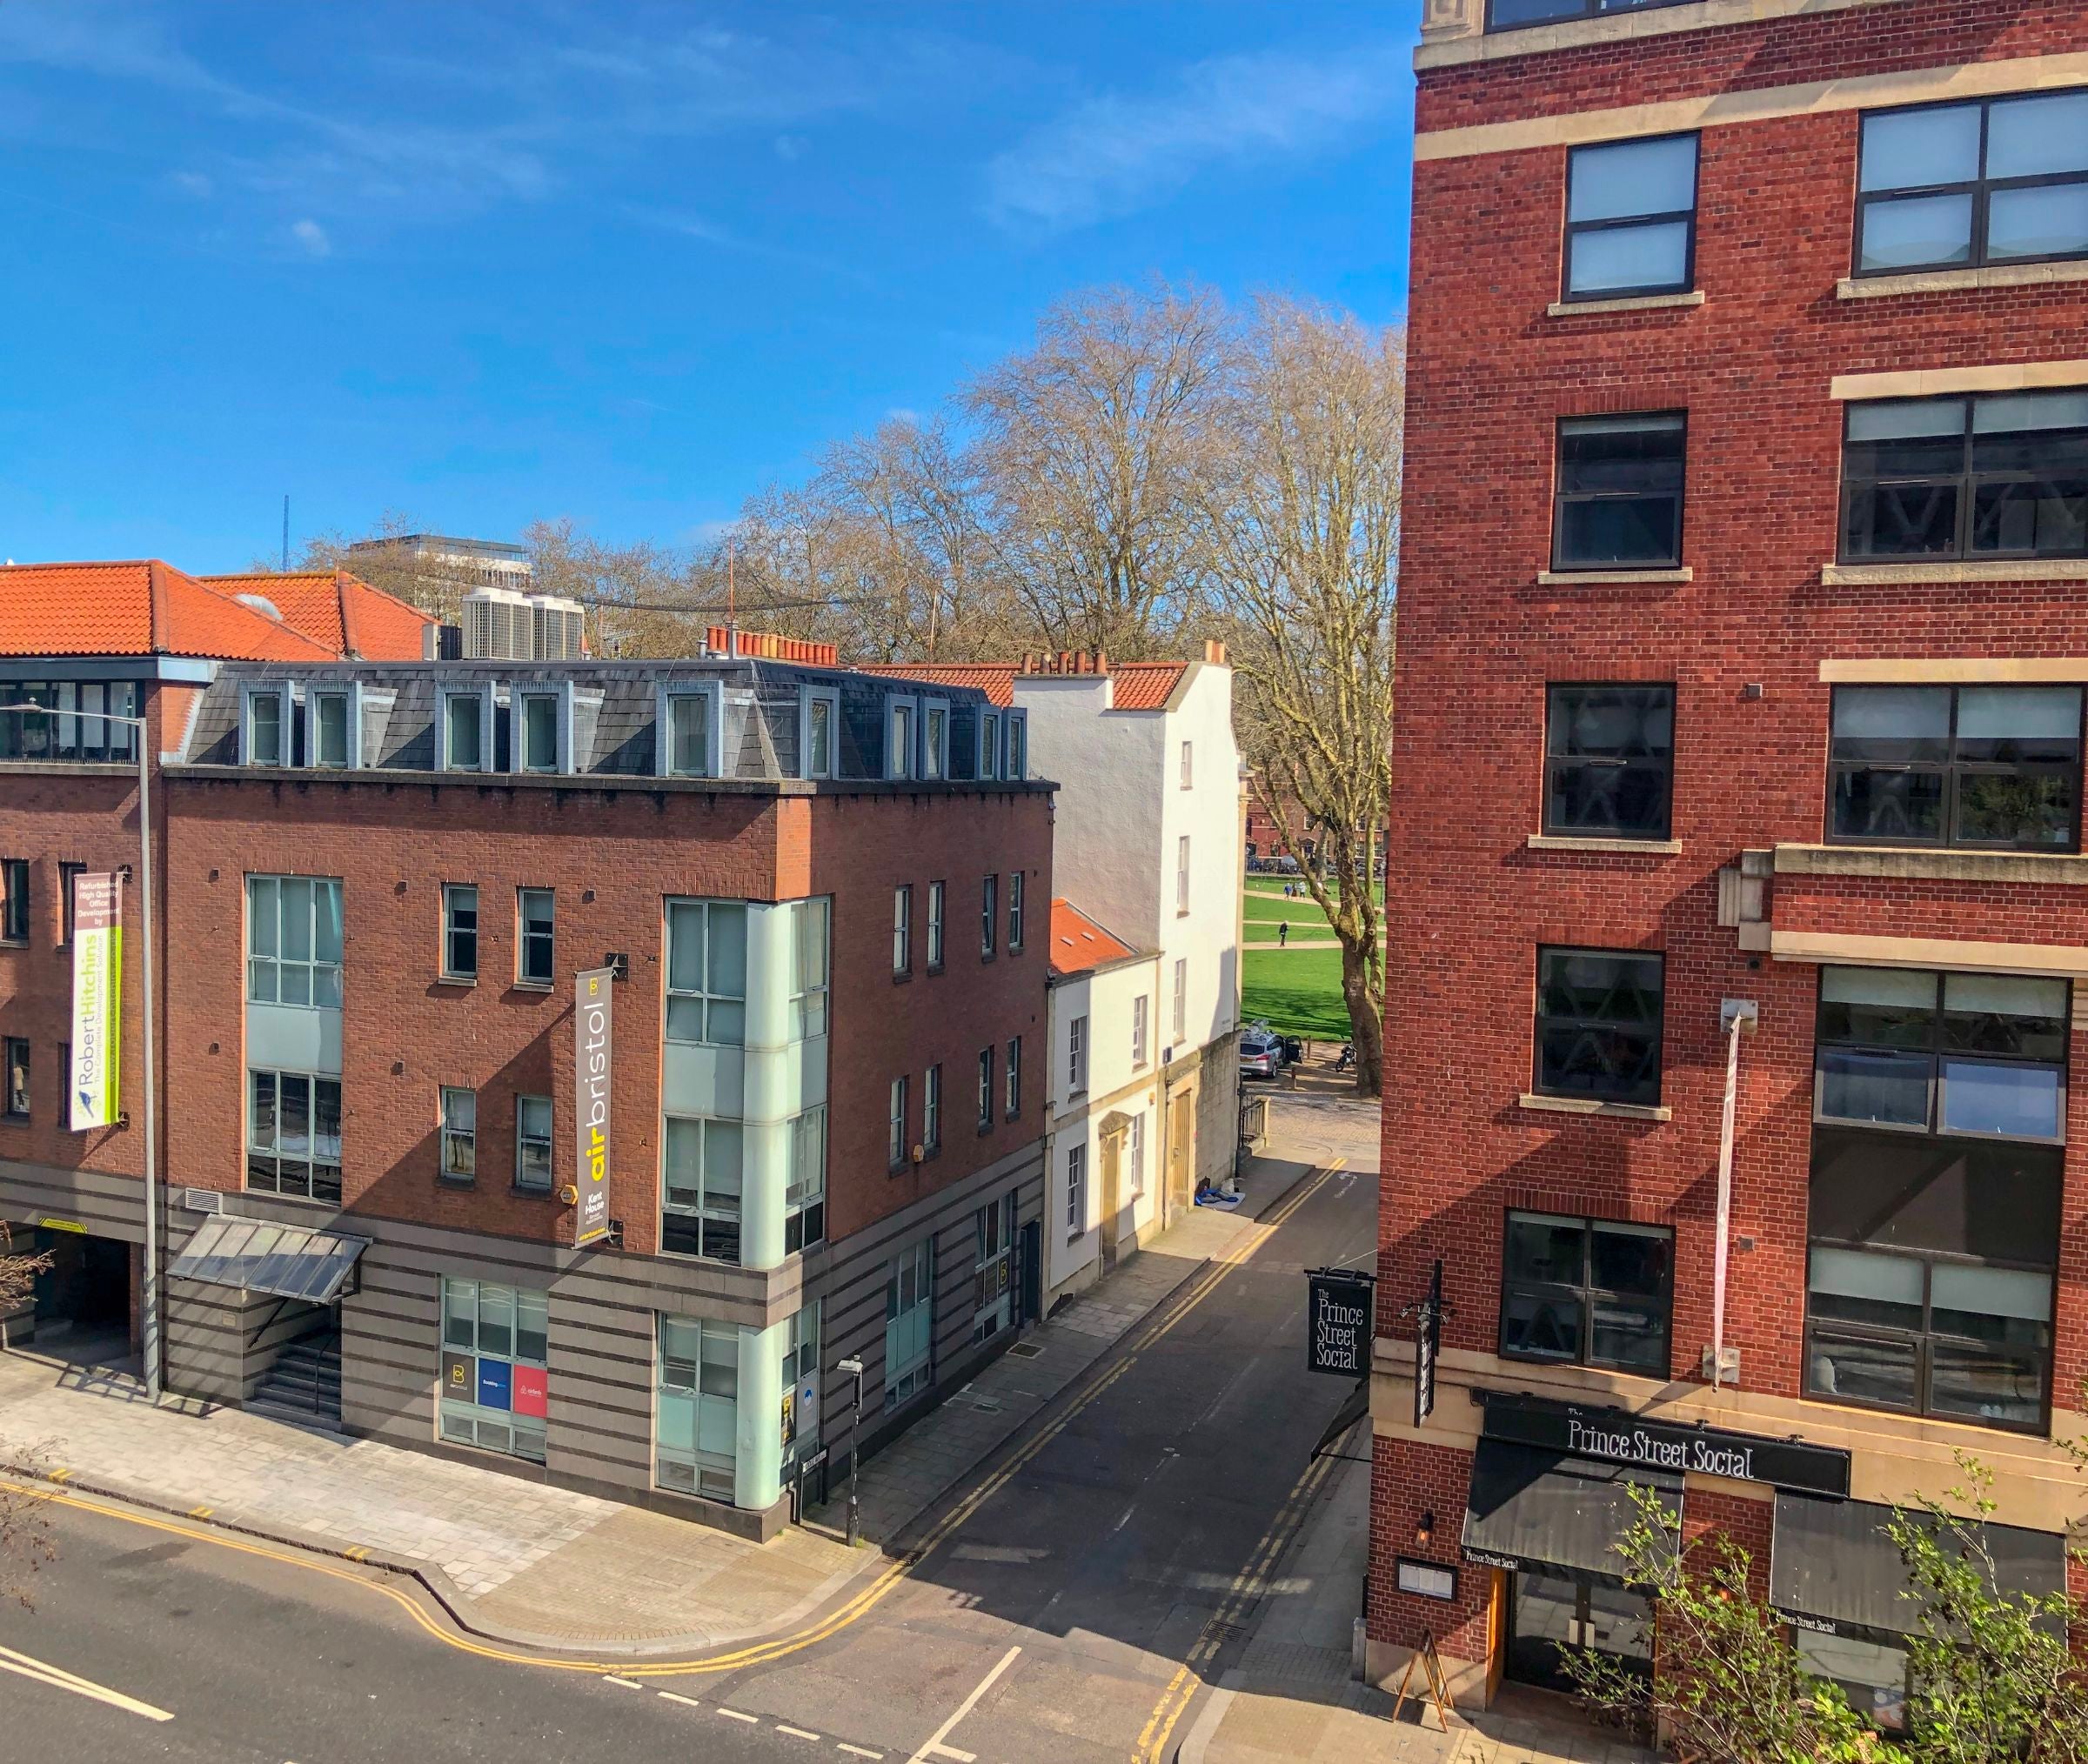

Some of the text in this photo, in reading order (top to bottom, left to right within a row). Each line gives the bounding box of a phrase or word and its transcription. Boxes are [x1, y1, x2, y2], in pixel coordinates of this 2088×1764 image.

[79, 889, 118, 900] High Quality
[78, 908, 119, 917] Development
[79, 935, 97, 1086] RobertHitchins
[588, 1191, 603, 1205] Kent
[586, 1201, 605, 1215] House
[1317, 1288, 1329, 1299] The
[1317, 1298, 1363, 1326] Prince
[1316, 1320, 1357, 1347] Street
[1316, 1343, 1358, 1370] Social
[1567, 1420, 1754, 1479] Prince Street Social
[1484, 1554, 1502, 1567] Street
[1502, 1557, 1519, 1570] Social
[1797, 1615, 1816, 1629] Street
[1816, 1620, 1837, 1634] Social
